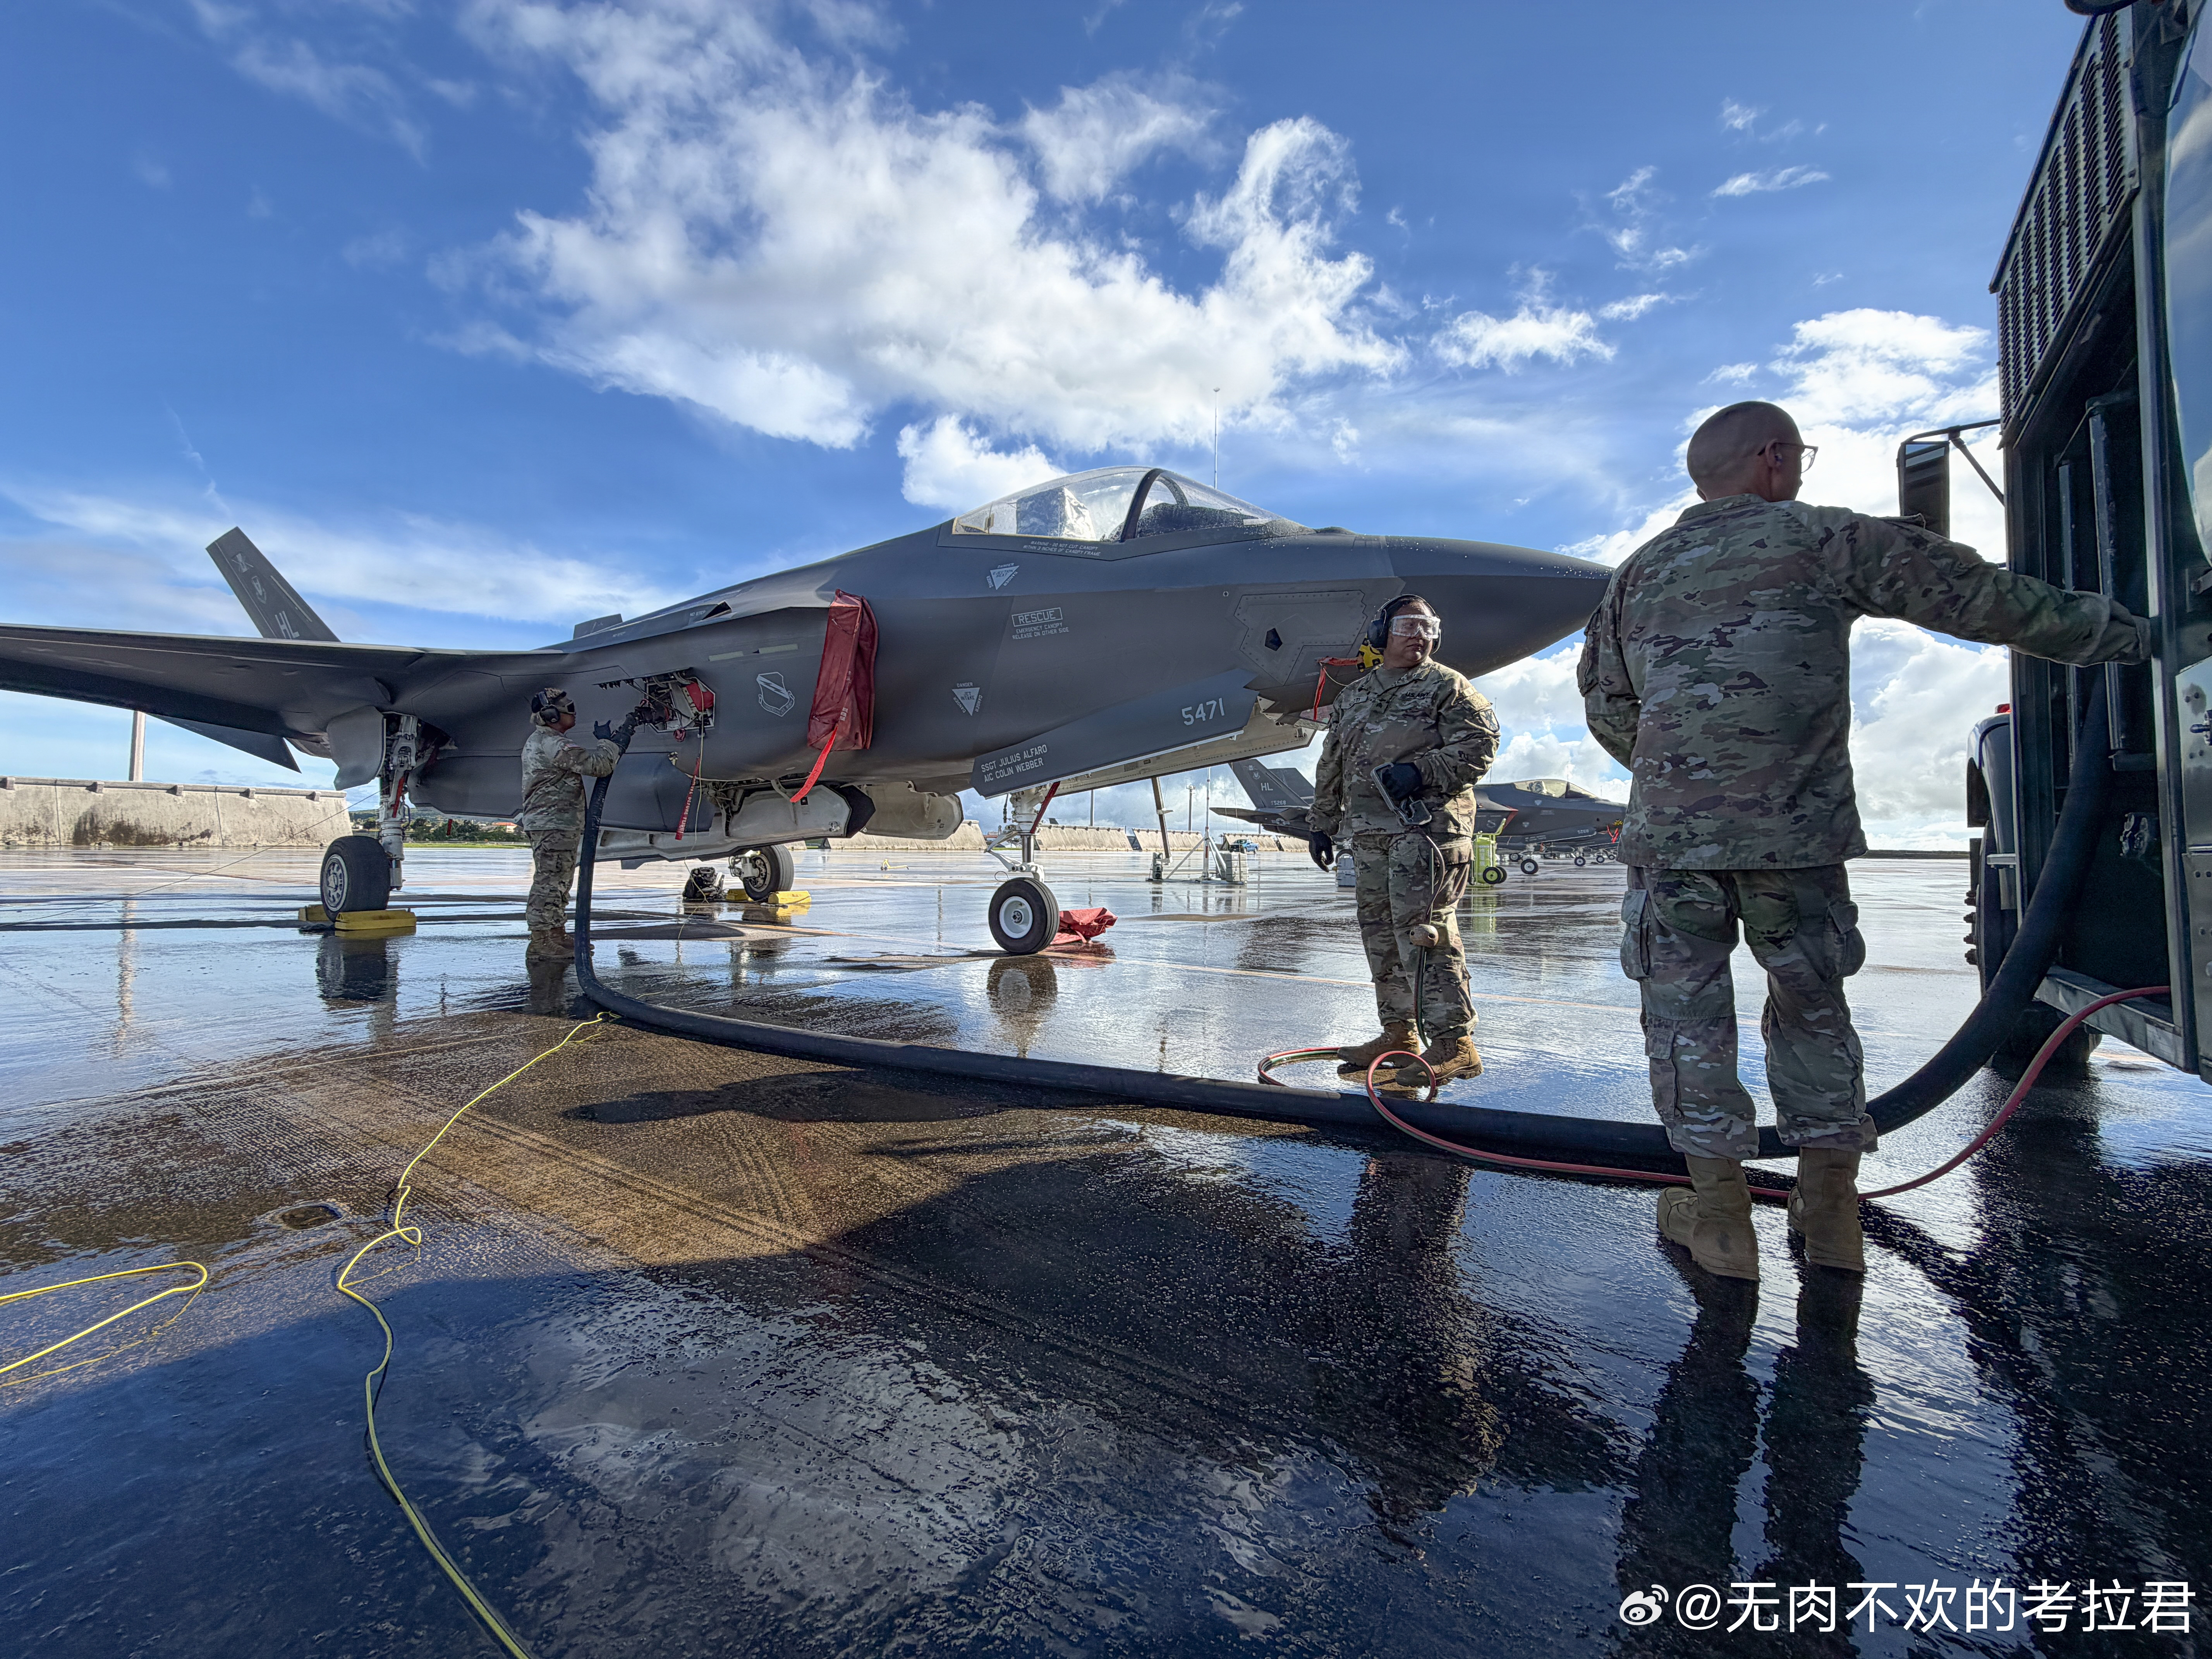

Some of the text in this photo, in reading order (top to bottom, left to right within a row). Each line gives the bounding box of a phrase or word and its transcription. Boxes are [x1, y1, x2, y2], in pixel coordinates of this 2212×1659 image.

[275, 610, 300, 639] HL
[1018, 610, 1056, 624] RESCUE
[1016, 625, 1042, 634] EMERGENCY
[1182, 697, 1224, 726] 5471
[981, 744, 1048, 773] SSGT JULIUS ALFARO
[995, 766, 1014, 779] COLIN
[1015, 757, 1044, 773] WEBBER
[1261, 782, 1273, 791] HL
